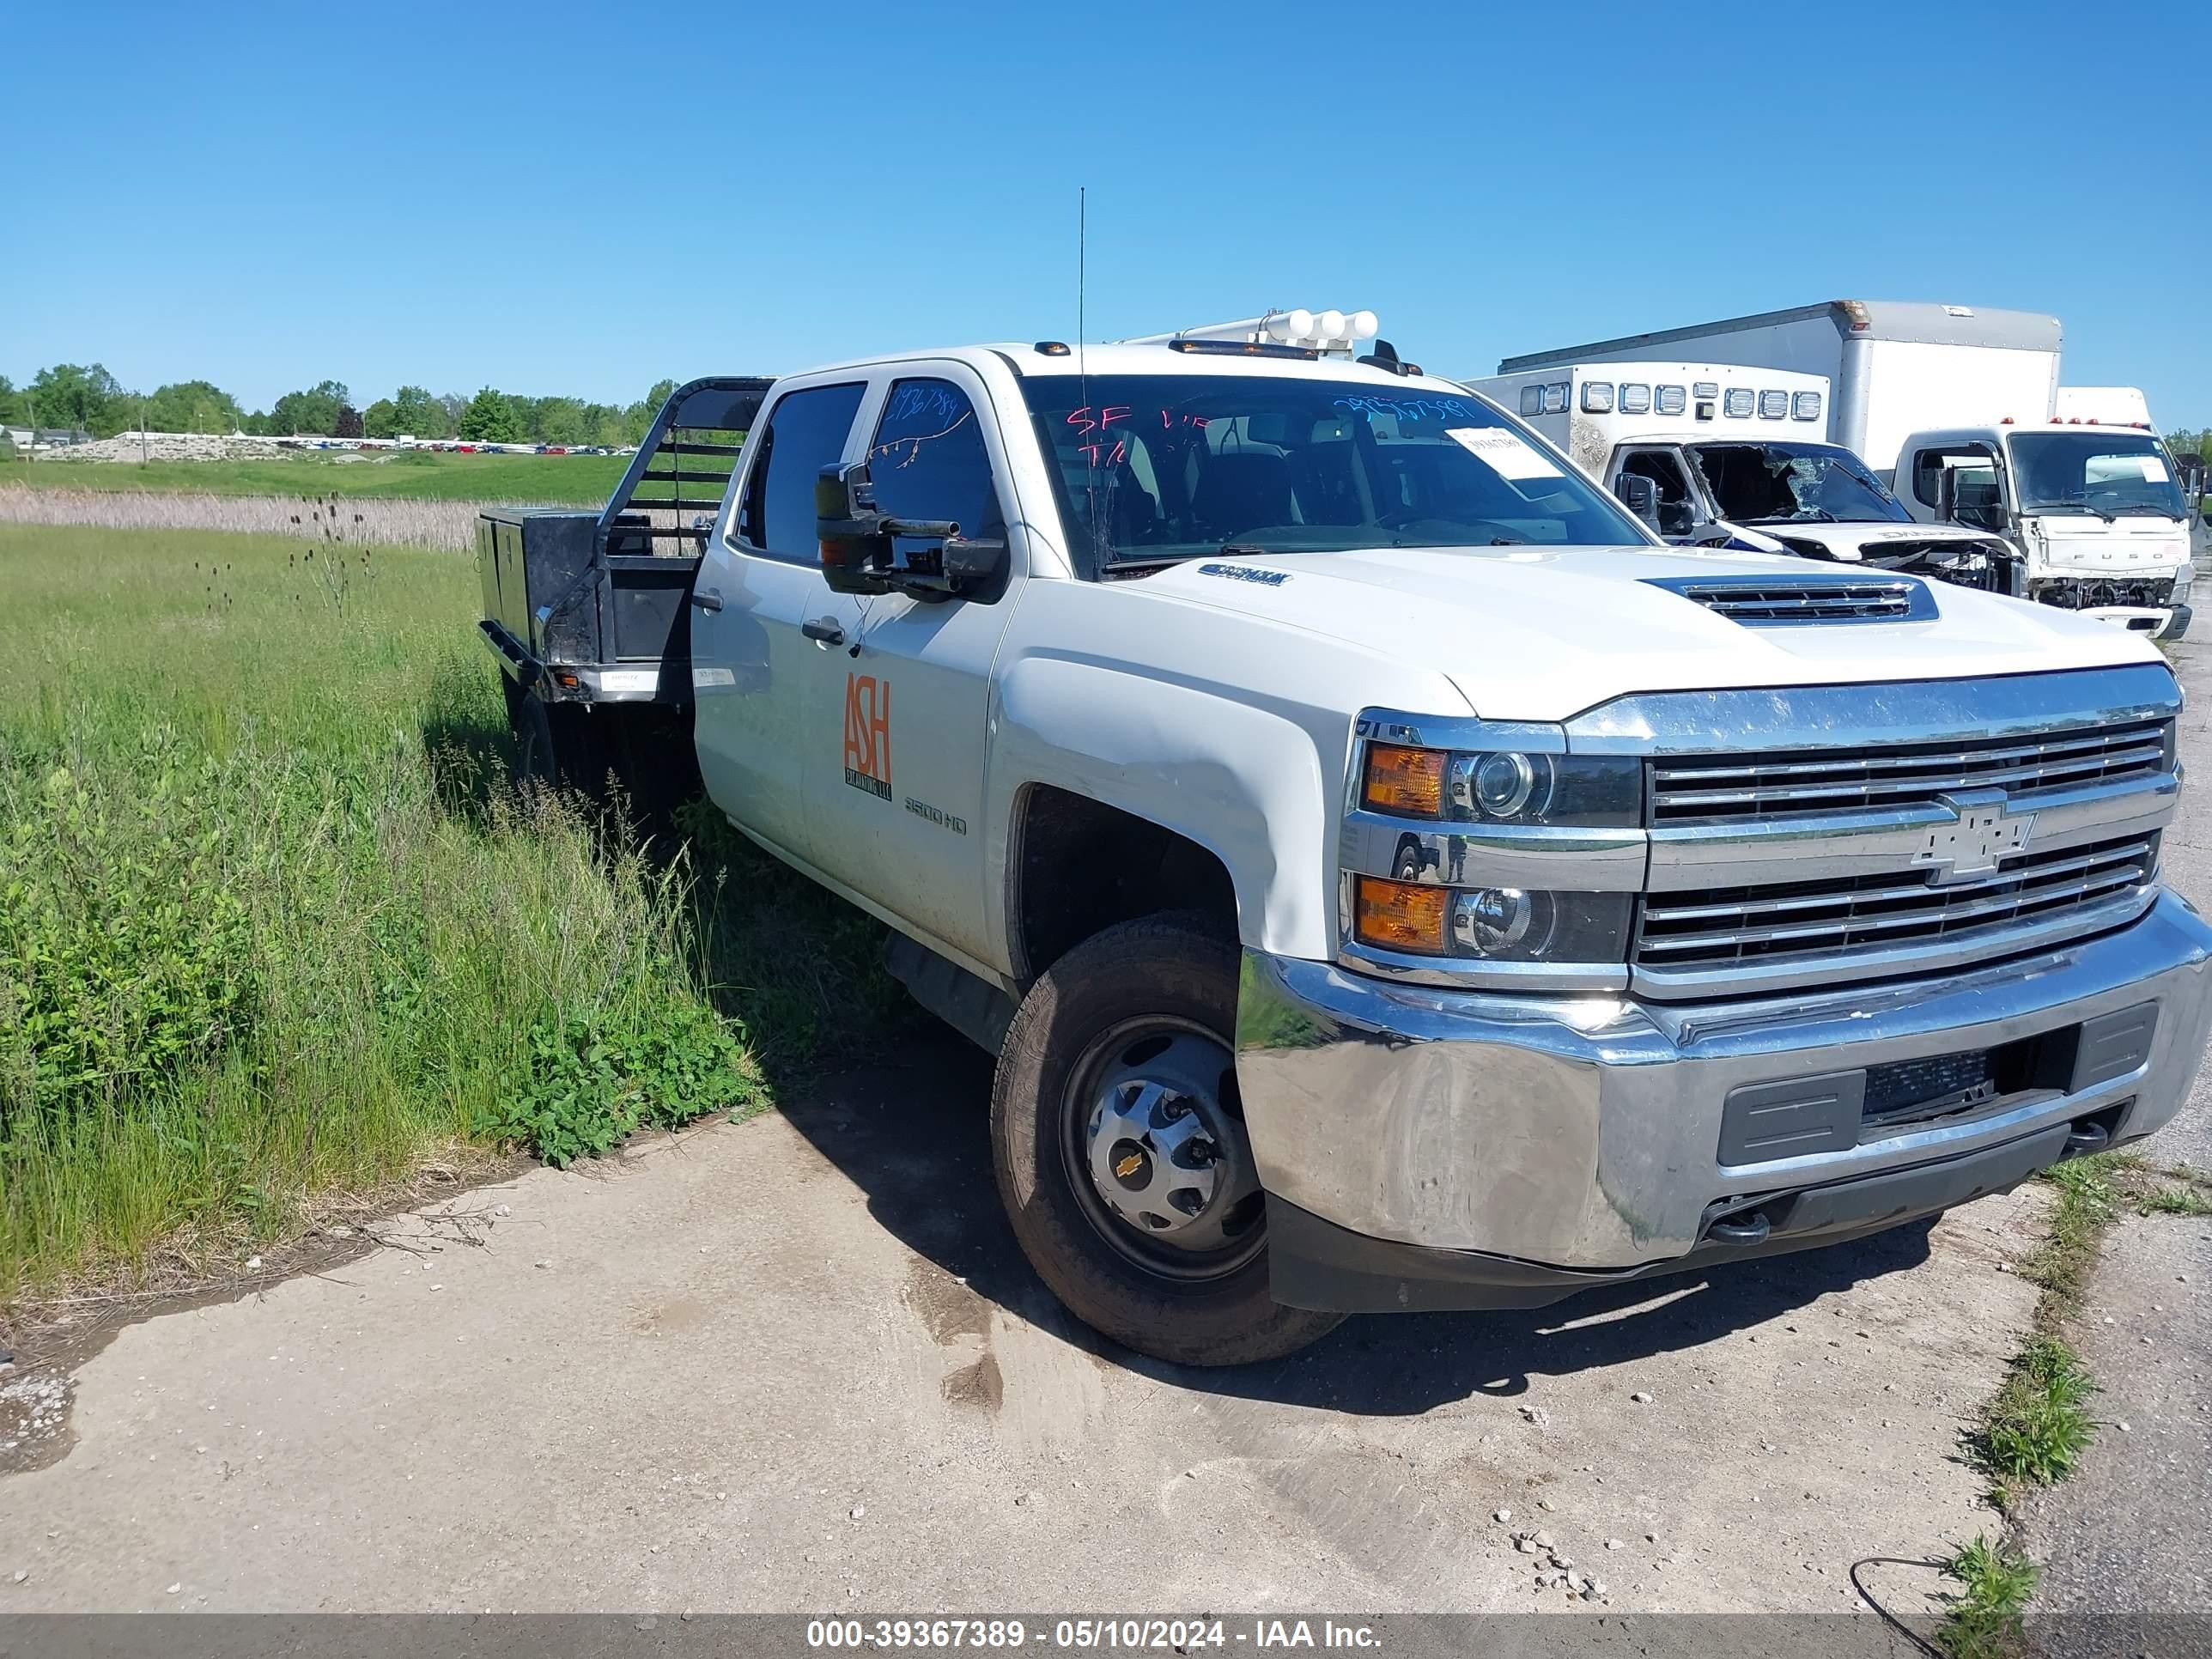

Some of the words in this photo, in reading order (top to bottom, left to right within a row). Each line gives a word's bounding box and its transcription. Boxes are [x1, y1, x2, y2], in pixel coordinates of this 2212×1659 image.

[1333, 398, 1476, 422] 39367389
[845, 672, 891, 785] ASH
[904, 797, 943, 825] 3500
[945, 813, 967, 836] HD
